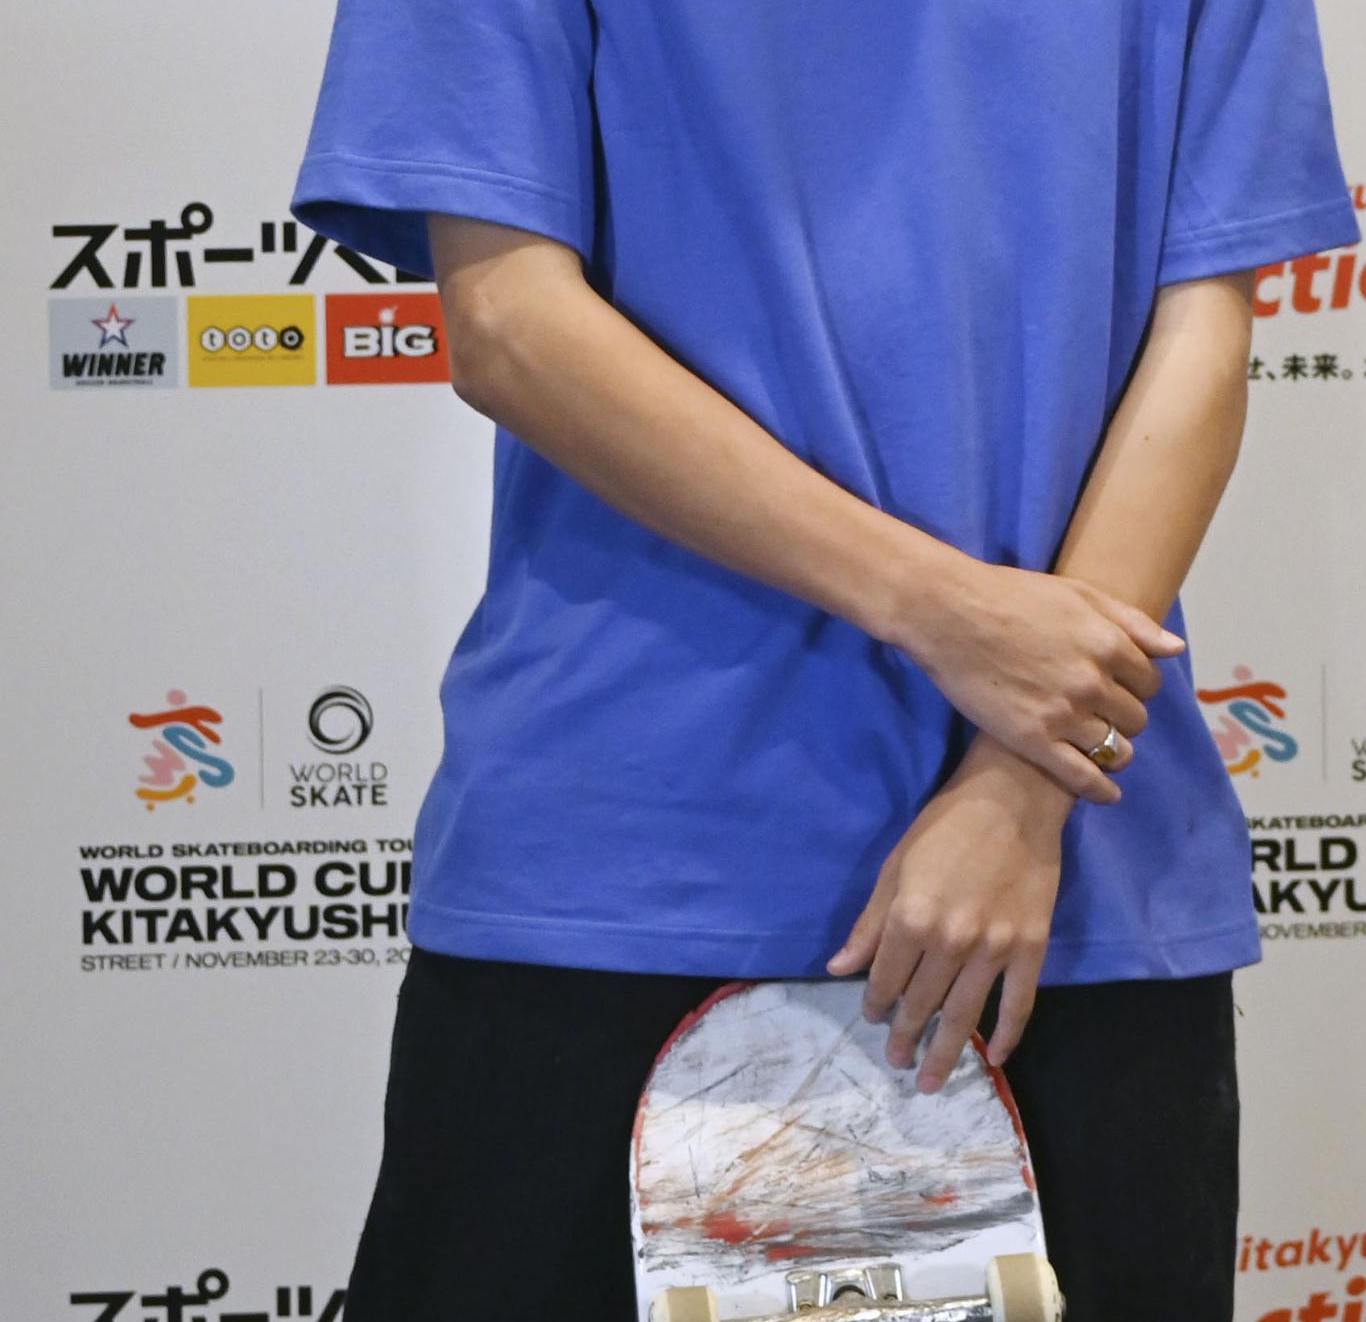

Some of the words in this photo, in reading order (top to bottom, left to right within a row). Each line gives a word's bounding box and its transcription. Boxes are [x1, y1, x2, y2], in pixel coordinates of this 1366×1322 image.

[62, 352, 166, 379] WINNER
[289, 763, 388, 783] WORLD
[290, 785, 388, 807] SKATE
[80, 845, 163, 859] WORLD
[172, 841, 368, 857] SKATEBOARDING
[1251, 837, 1357, 872] RLD
[80, 864, 297, 903] WORLD
[82, 903, 408, 945] KITAKYUSH
[81, 953, 167, 972] STREET
[185, 950, 309, 969] NOVEMBER
[315, 948, 381, 968] 23-30,
